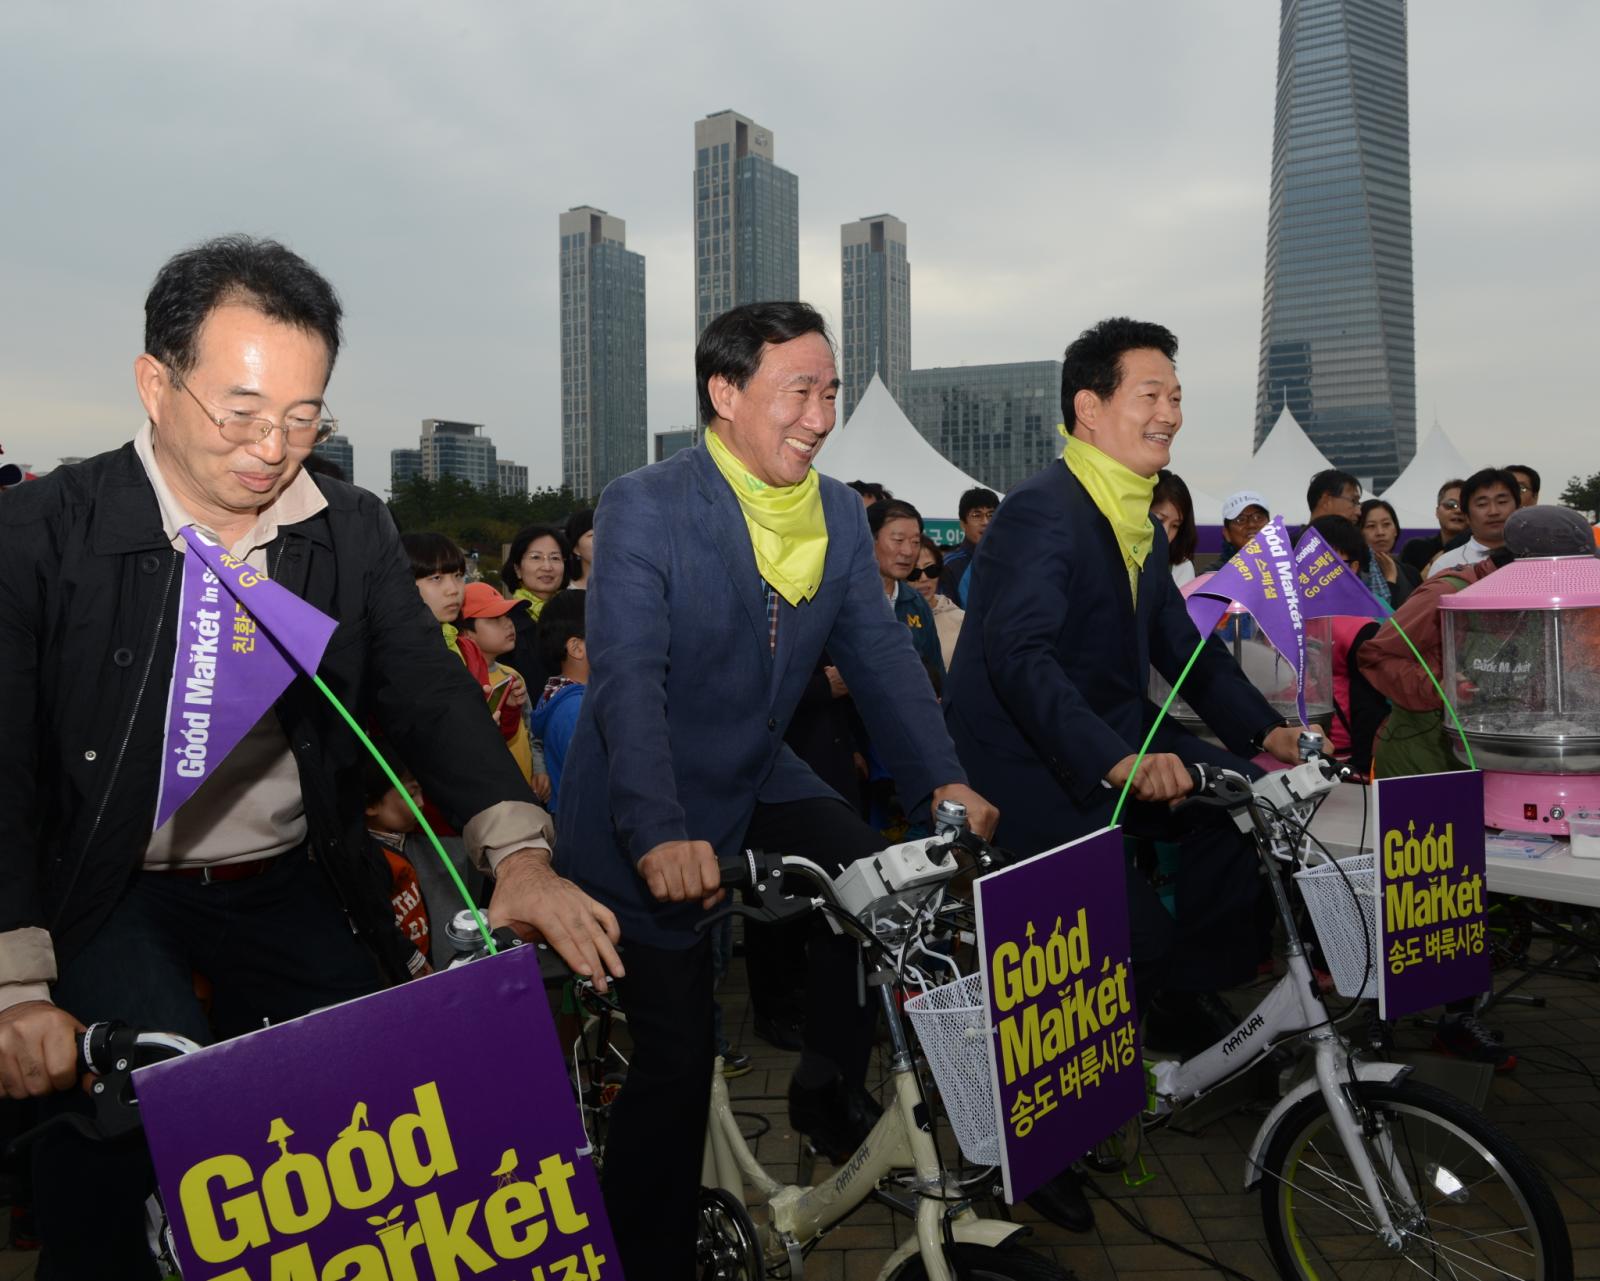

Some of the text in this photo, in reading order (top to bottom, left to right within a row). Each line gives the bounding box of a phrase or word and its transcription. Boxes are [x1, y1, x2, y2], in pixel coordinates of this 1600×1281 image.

[201, 587, 219, 603] in
[1261, 520, 1288, 557] ood
[1275, 561, 1303, 630] Market
[1304, 585, 1320, 598] Go
[184, 608, 222, 706] Market
[175, 711, 211, 778] Good
[1383, 820, 1455, 880] Good
[1385, 867, 1484, 933] Market
[992, 907, 1091, 1012] Good
[1388, 920, 1486, 975] 송도 벼룩시장
[998, 957, 1131, 1086] Market
[1010, 1021, 1136, 1138] 송도 벼룩시장
[179, 1080, 459, 1264] Good
